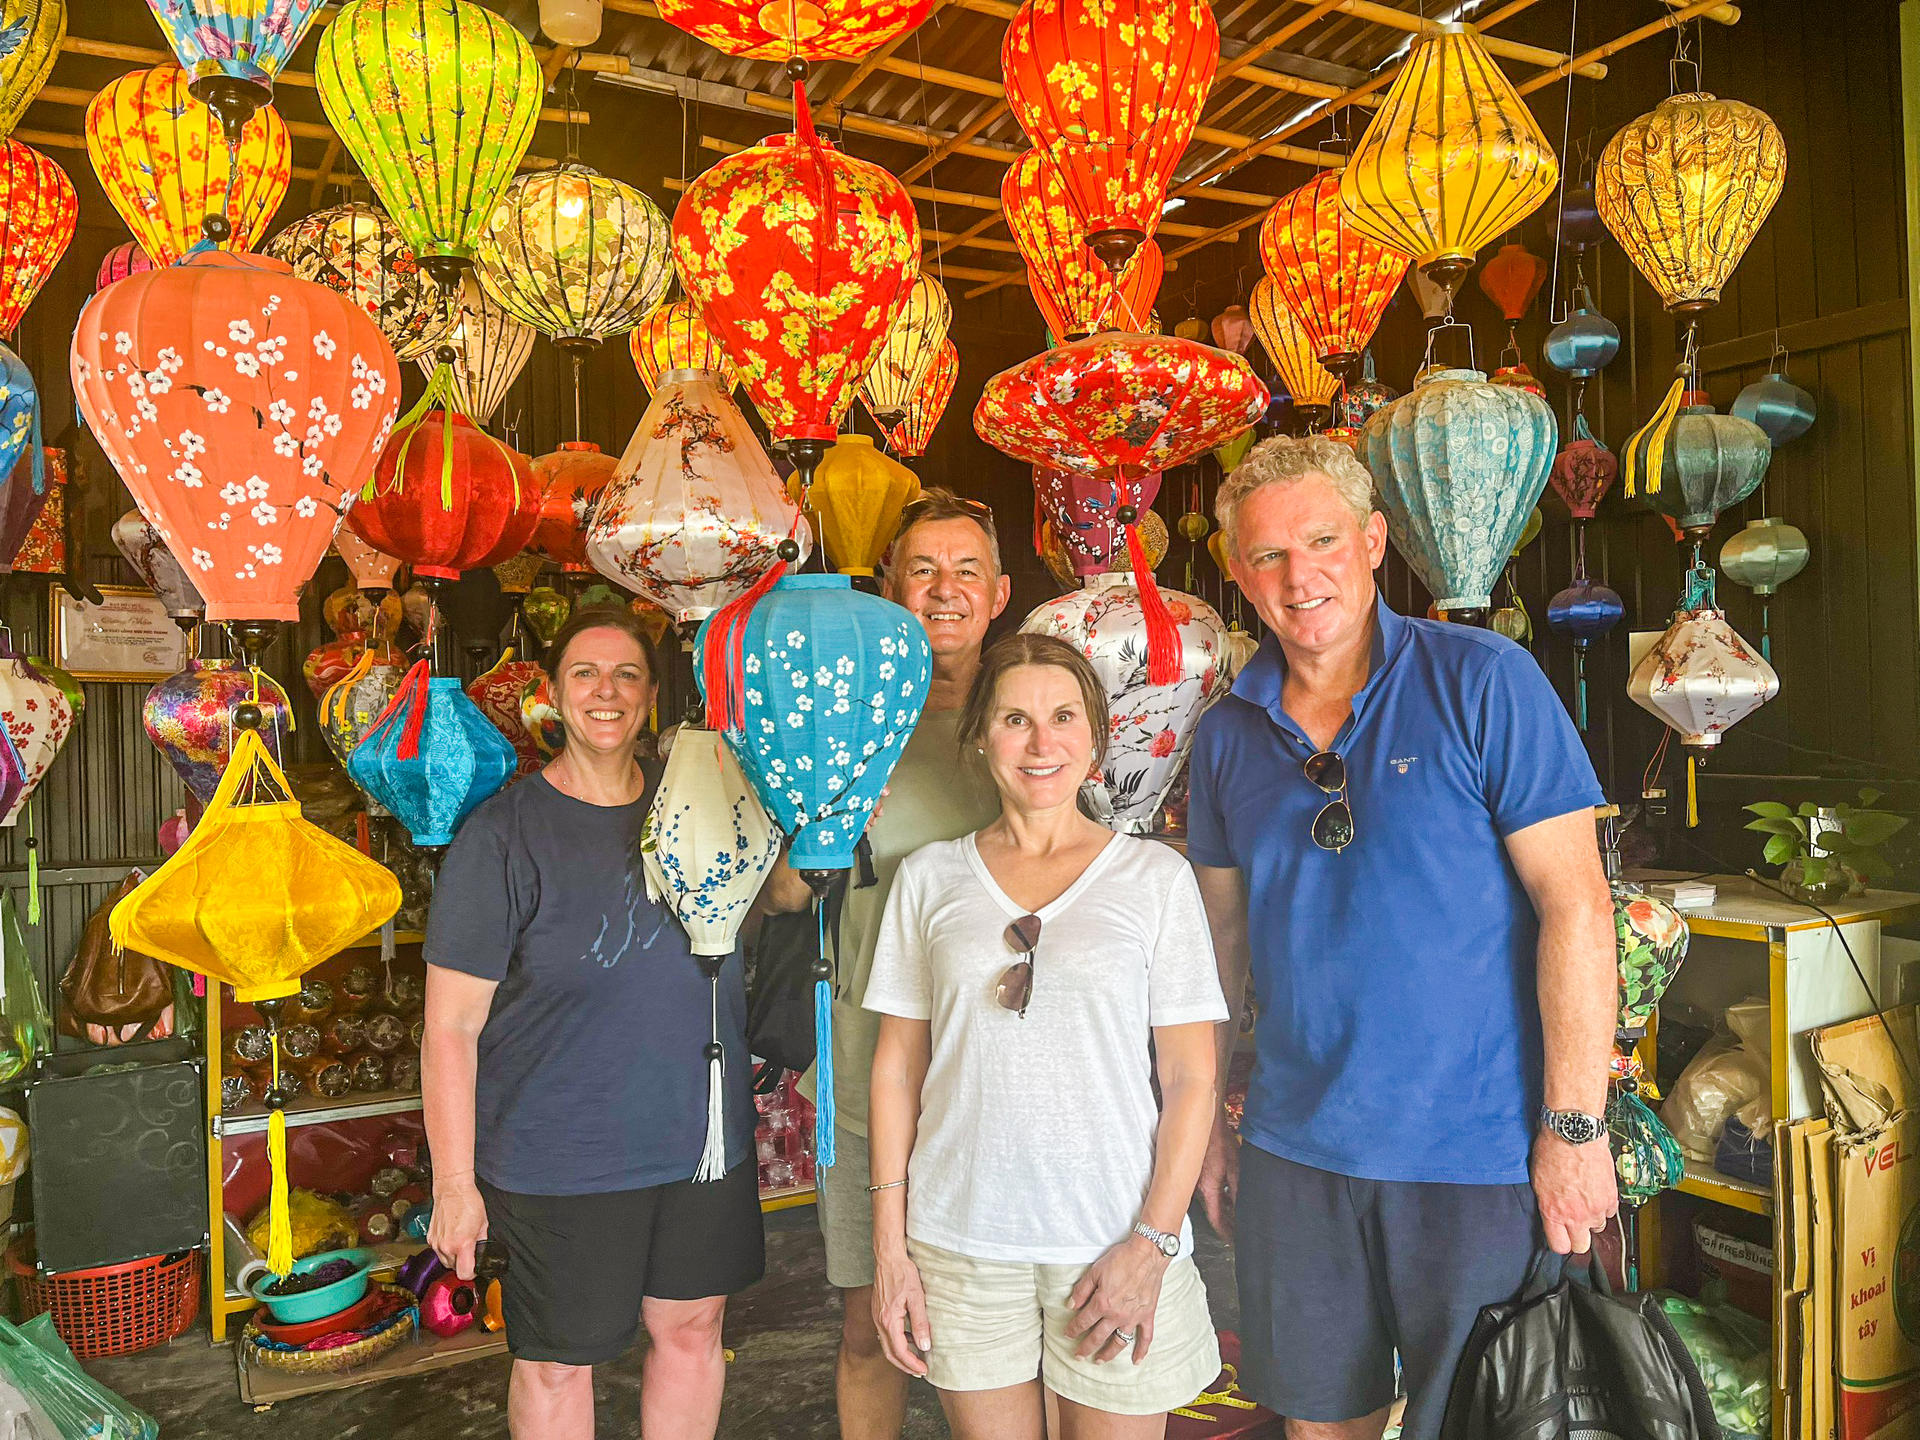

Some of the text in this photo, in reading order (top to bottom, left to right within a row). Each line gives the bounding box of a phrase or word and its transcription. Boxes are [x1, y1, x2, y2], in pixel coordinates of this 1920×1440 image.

[1390, 757, 1418, 765] GANT
[1850, 1275, 1886, 1310] khoai
[1858, 1319, 1879, 1340] tây
